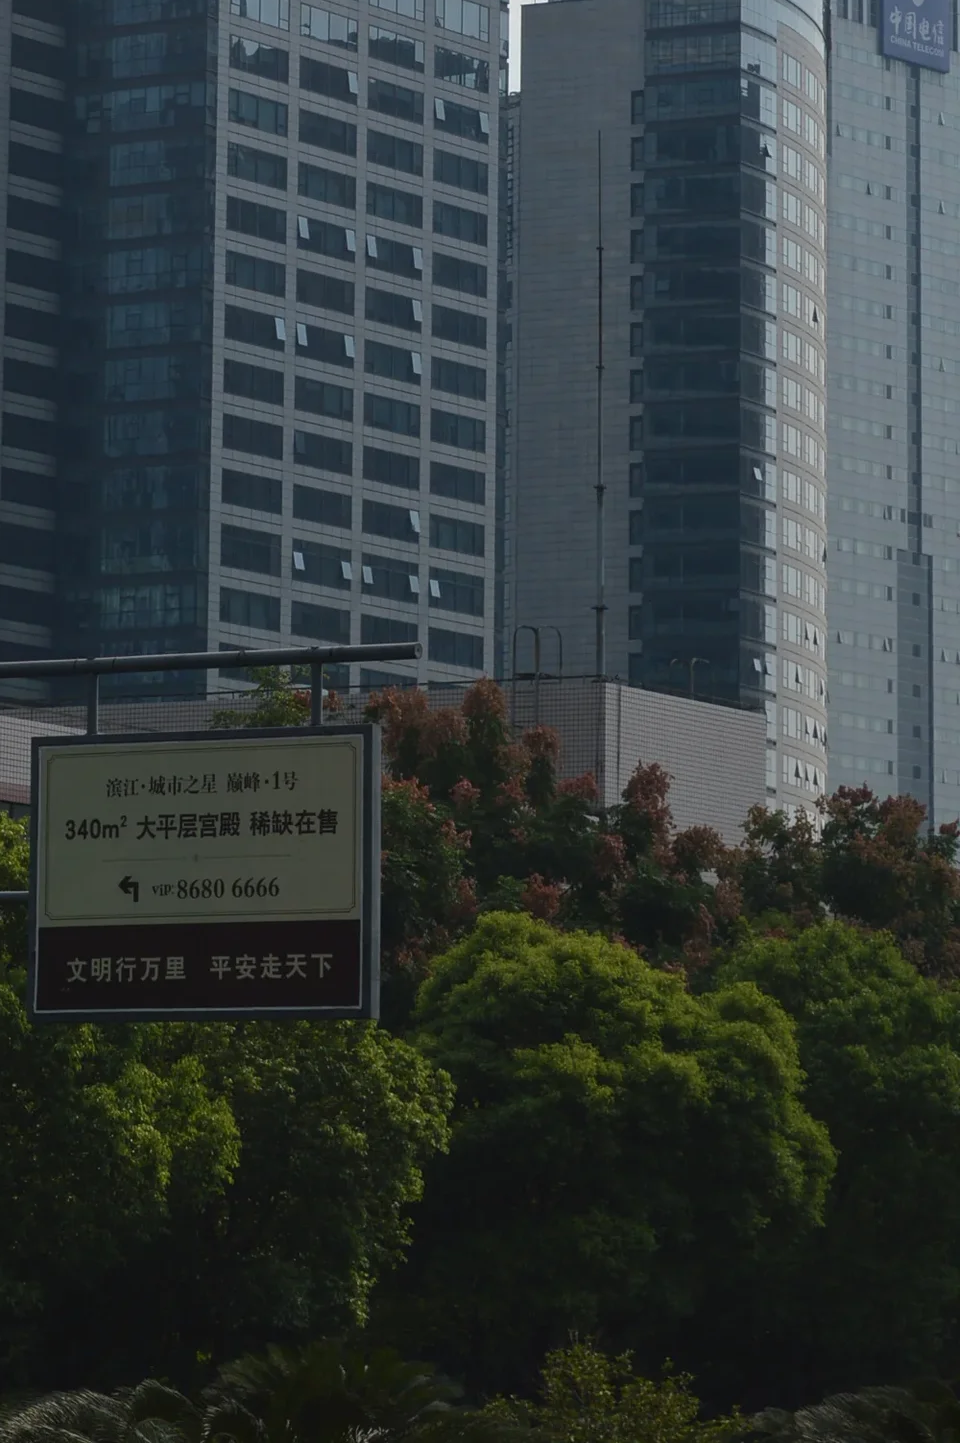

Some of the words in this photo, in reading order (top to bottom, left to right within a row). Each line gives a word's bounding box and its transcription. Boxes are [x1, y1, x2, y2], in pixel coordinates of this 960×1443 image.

[889, 5, 945, 46] 中国电信
[890, 35, 912, 49] CHINA
[912, 41, 945, 58] TELECOM
[136, 811, 240, 840] 大平层宫殿
[249, 808, 339, 836] 稀缺在售
[232, 876, 280, 898] 6666
[65, 955, 187, 984] 文明行万里
[209, 953, 334, 981] 平安走天下
